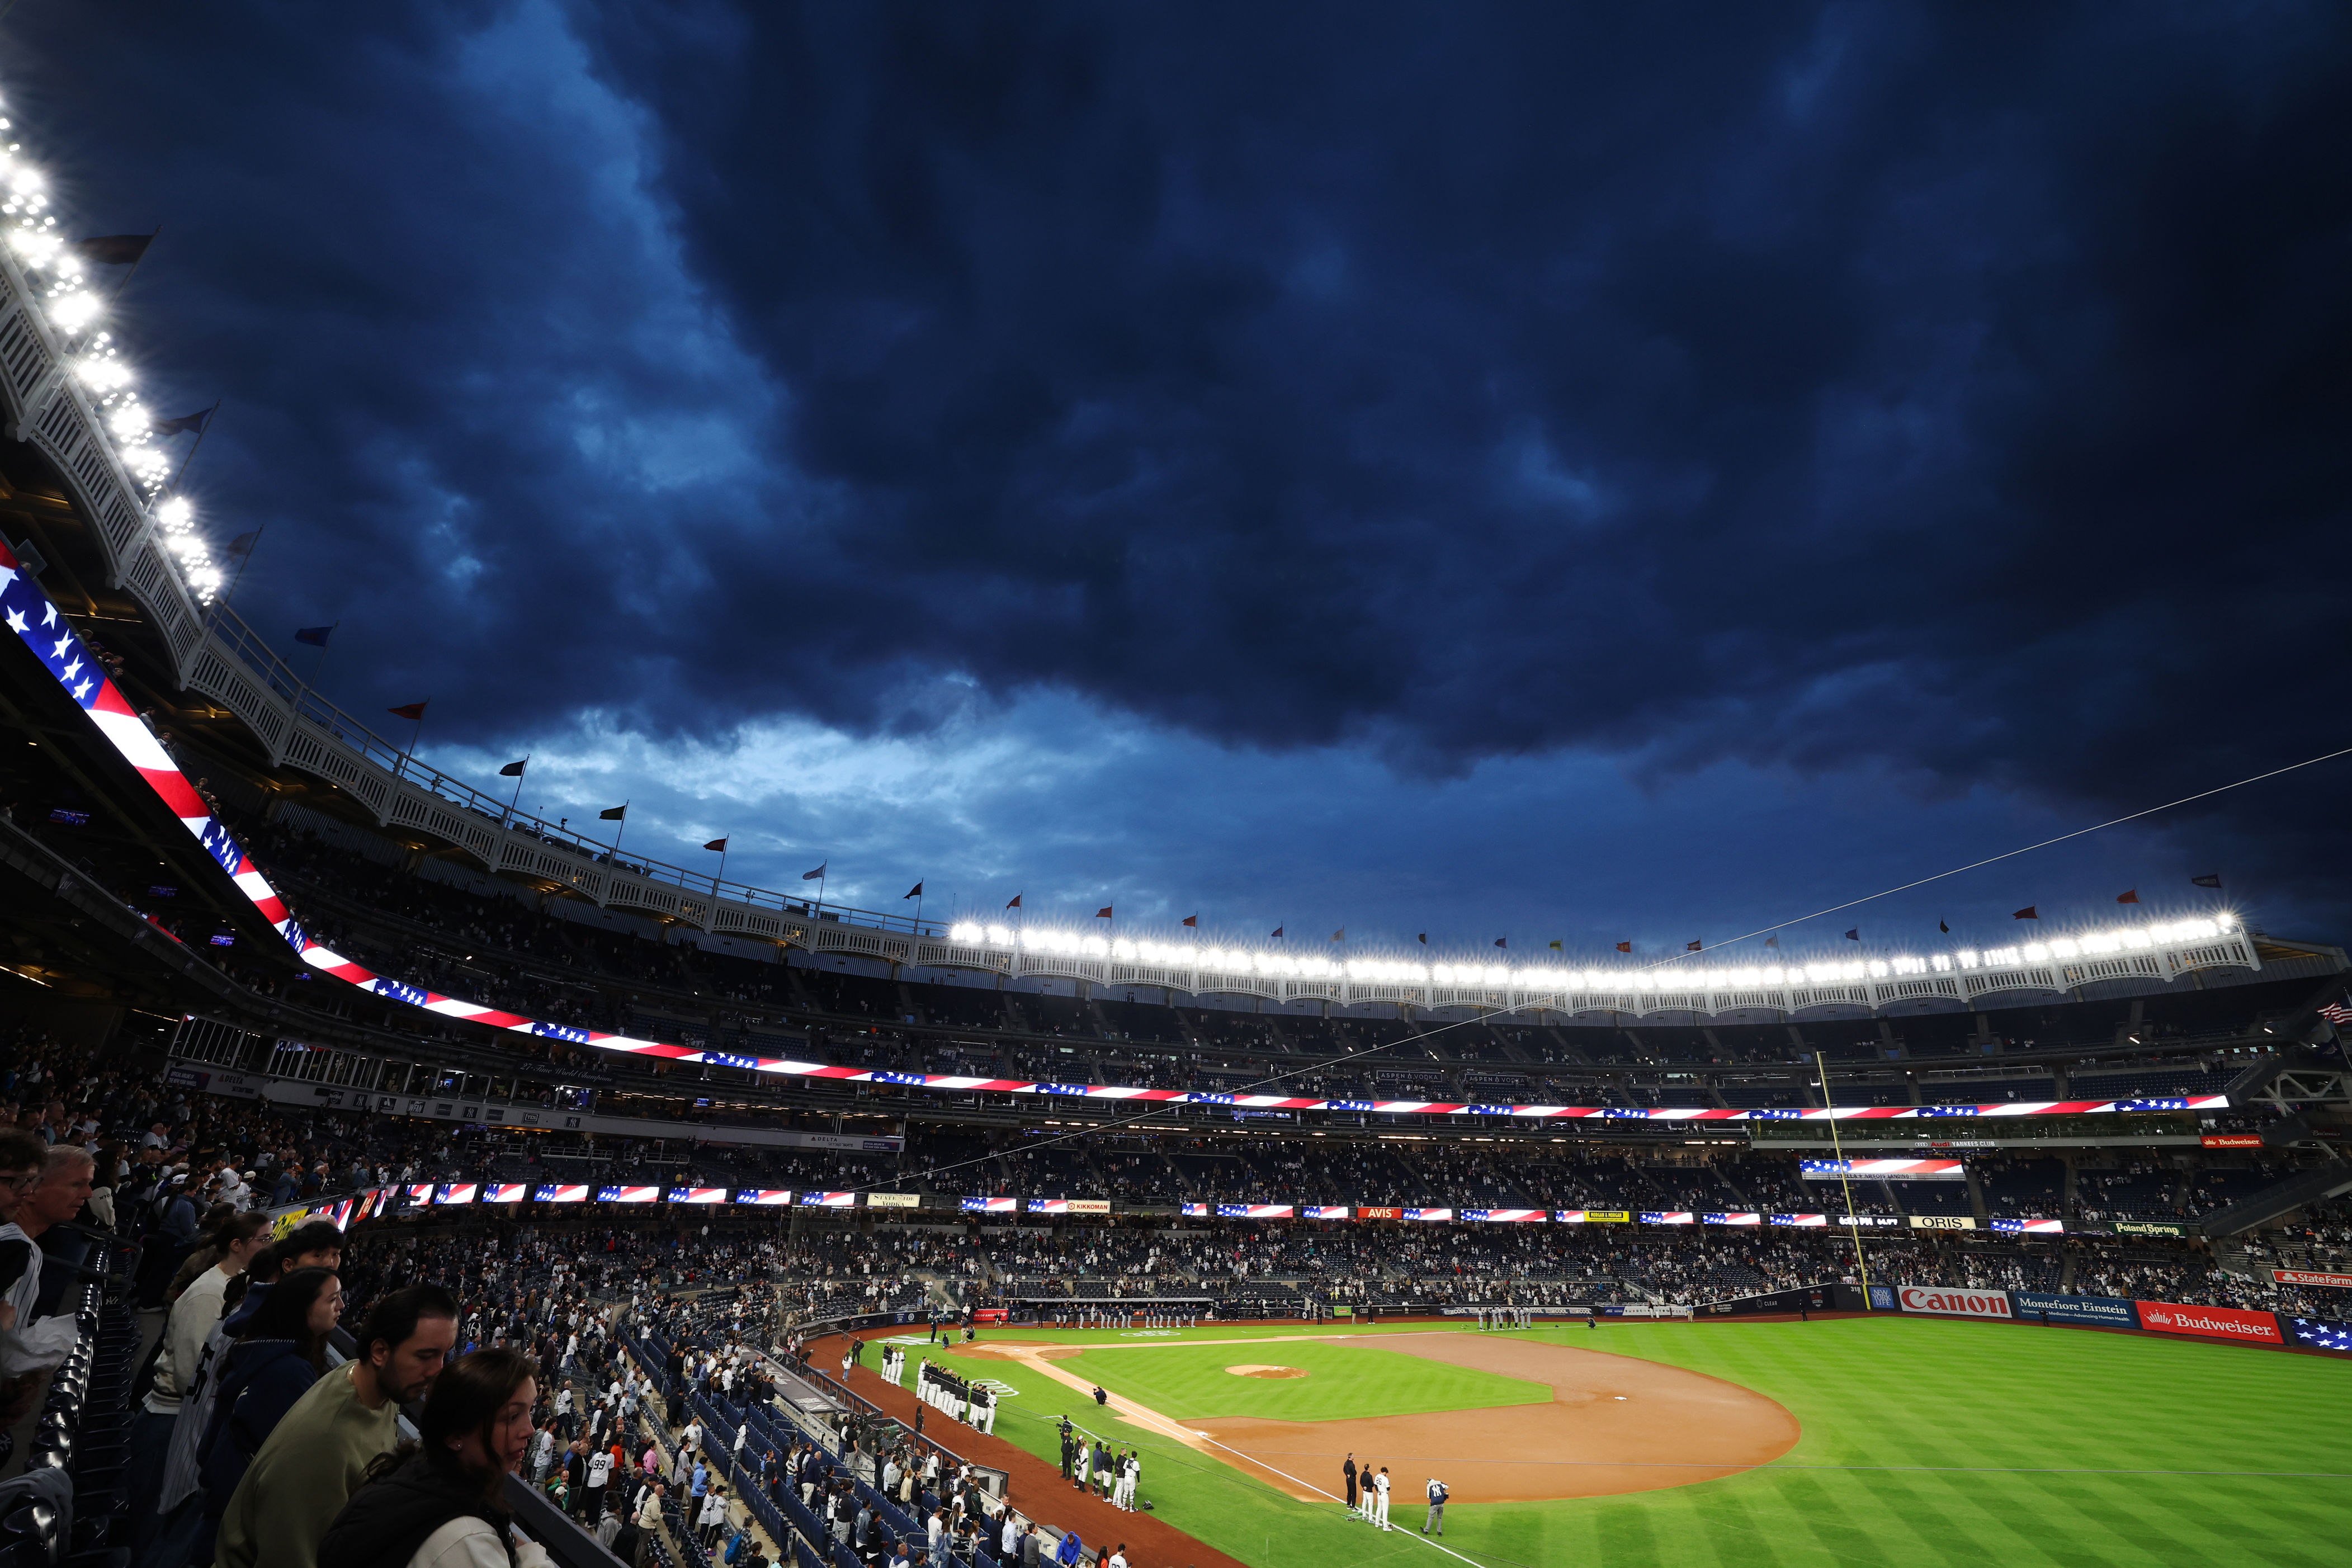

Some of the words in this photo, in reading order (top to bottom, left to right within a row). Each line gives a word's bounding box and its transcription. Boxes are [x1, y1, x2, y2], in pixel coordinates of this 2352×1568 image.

[225, 1075, 243, 1084] DELTA
[1368, 1208, 1392, 1218] AVIS
[1922, 1217, 1962, 1228] ORIS
[2115, 1222, 2147, 1232] Poland
[2146, 1224, 2179, 1235] Spring
[1901, 1289, 2008, 1314] Canon
[2018, 1297, 2080, 1311] Montefiore
[2081, 1301, 2127, 1315] Einstein
[2174, 1313, 2272, 1336] Budweiser
[593, 1460, 606, 1470] 99
[1376, 1477, 1382, 1485] 26
[1432, 1484, 1443, 1498] NY
